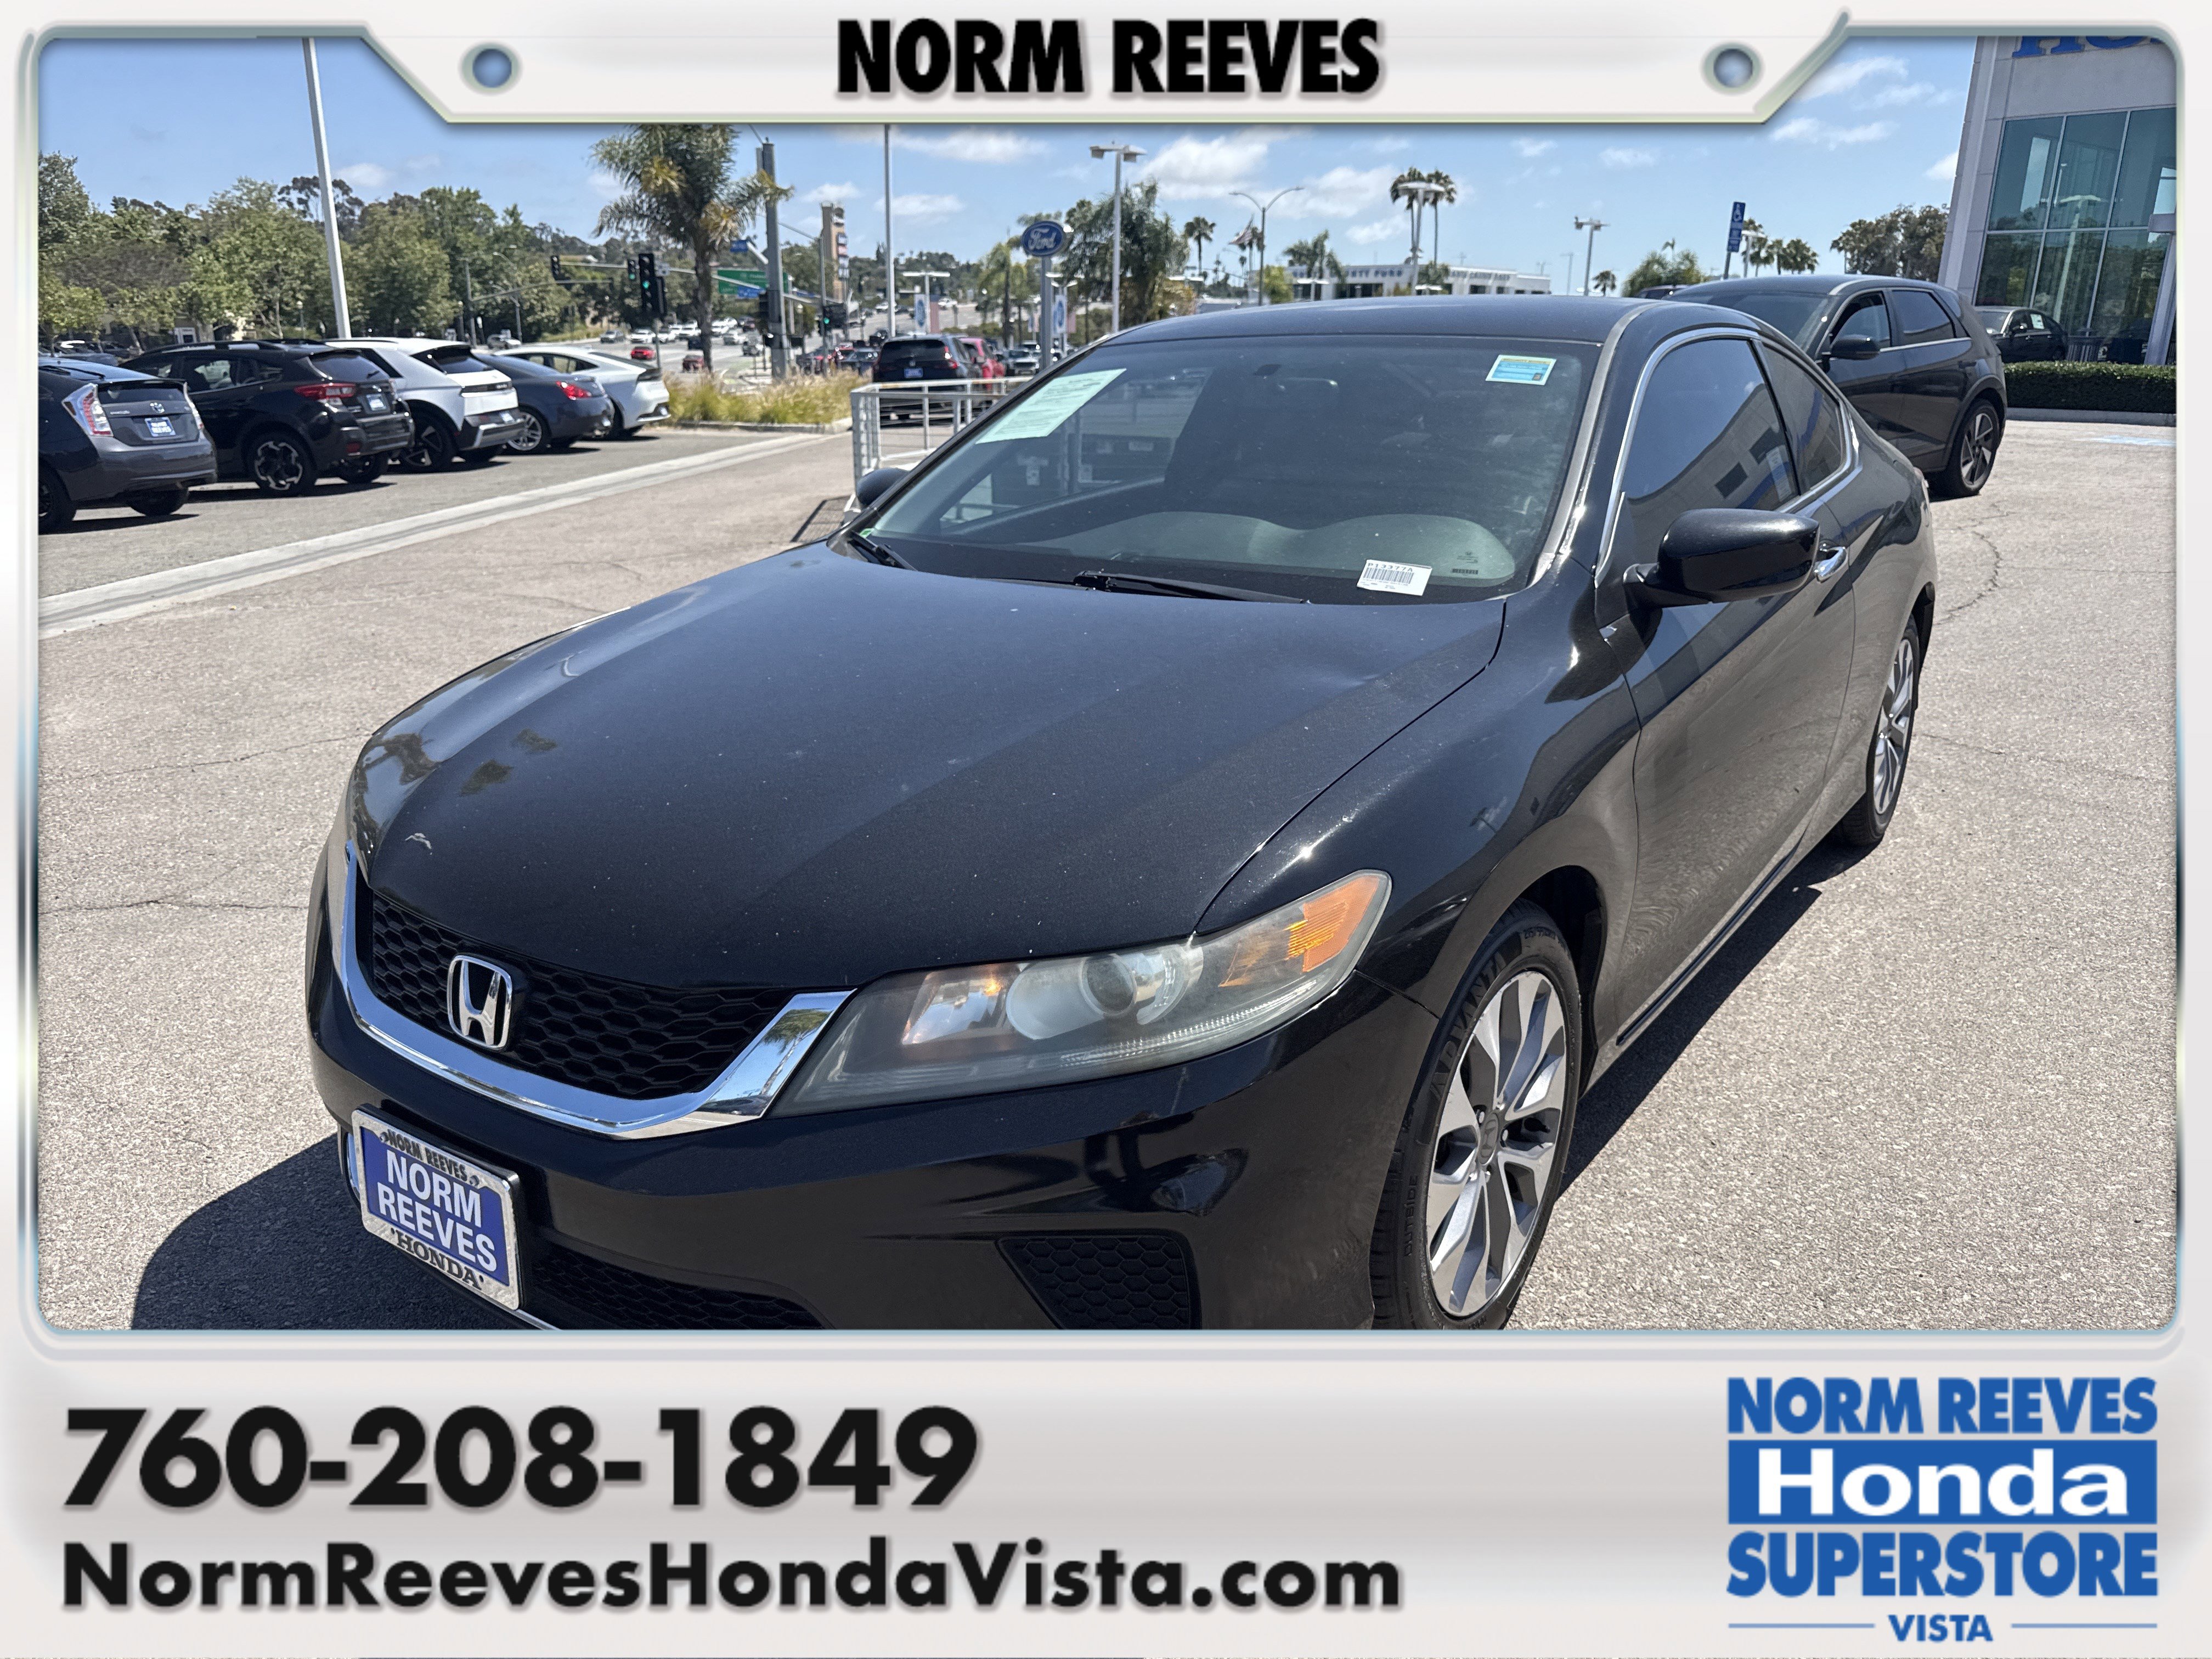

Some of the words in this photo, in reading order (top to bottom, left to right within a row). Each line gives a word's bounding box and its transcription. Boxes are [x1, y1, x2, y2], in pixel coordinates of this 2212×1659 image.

[1028, 228, 1057, 250] Ford
[387, 1128, 422, 1161] NORM
[425, 1148, 468, 1182] REEVES
[386, 1149, 482, 1228] NORM
[377, 1182, 497, 1272] REEVES
[396, 1229, 481, 1290] HONDA
